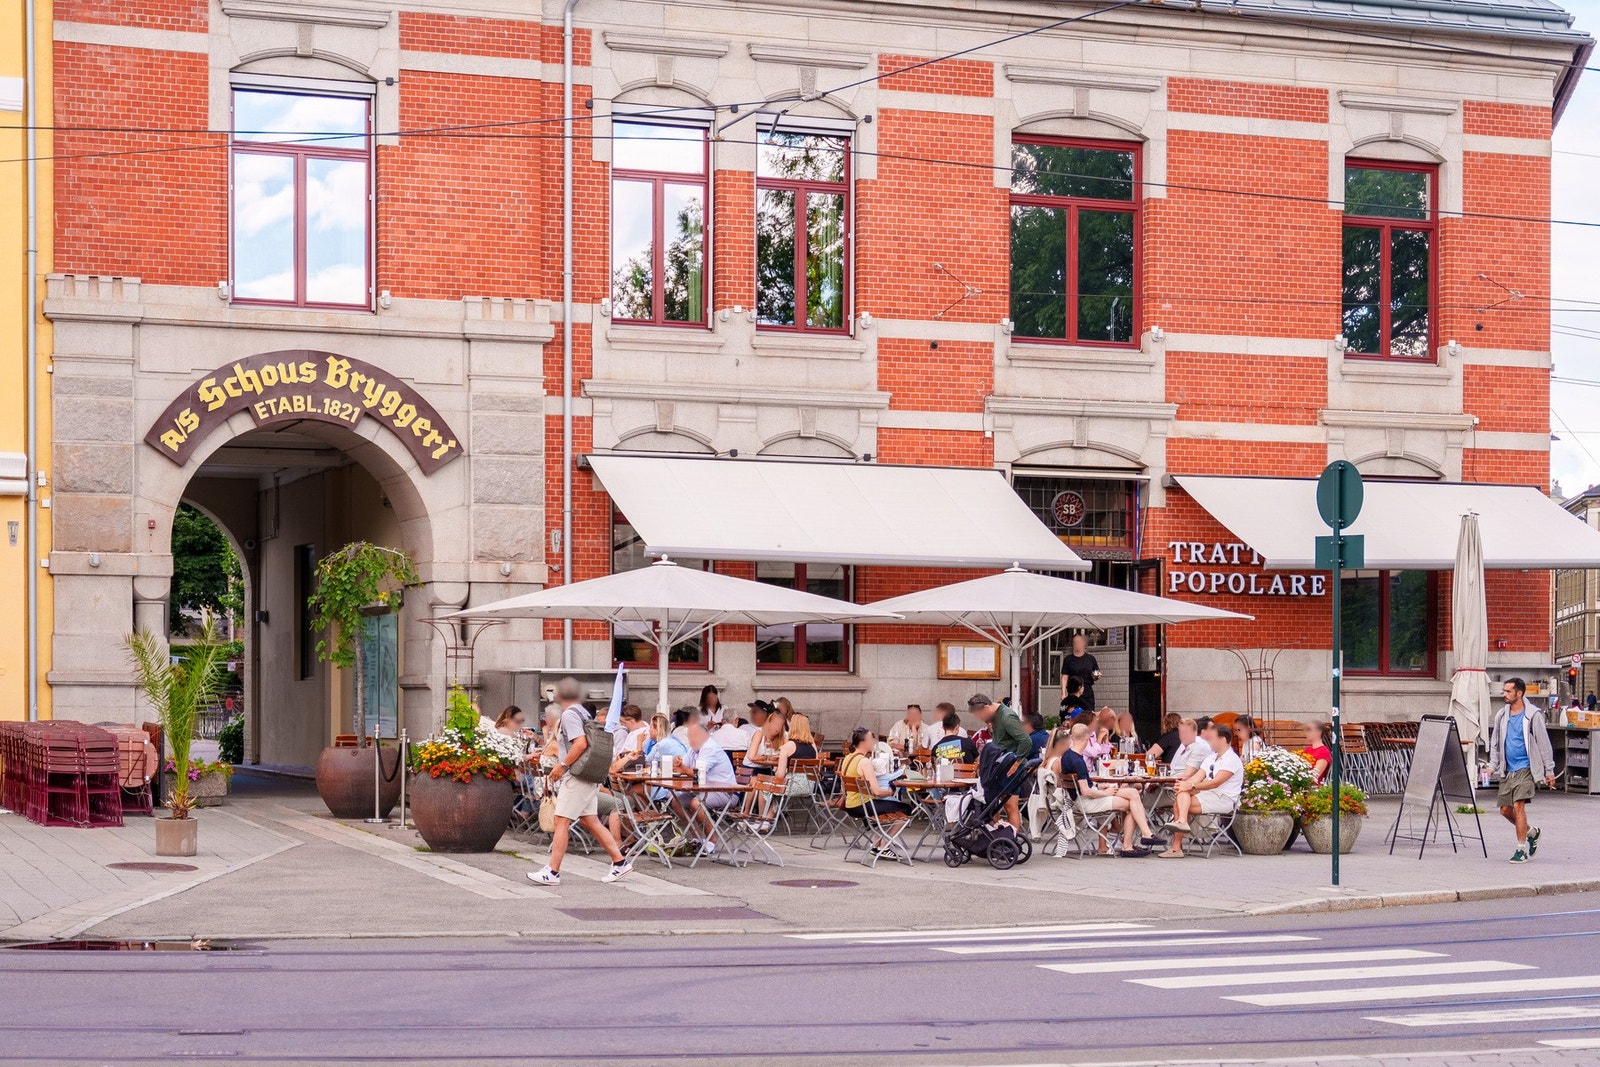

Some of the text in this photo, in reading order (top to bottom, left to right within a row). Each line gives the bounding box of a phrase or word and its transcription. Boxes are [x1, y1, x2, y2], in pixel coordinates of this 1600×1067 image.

[160, 355, 457, 460] A/S Schous Bryggeri
[1062, 504, 1076, 515] SB
[1168, 571, 1326, 596] POPOLARE
